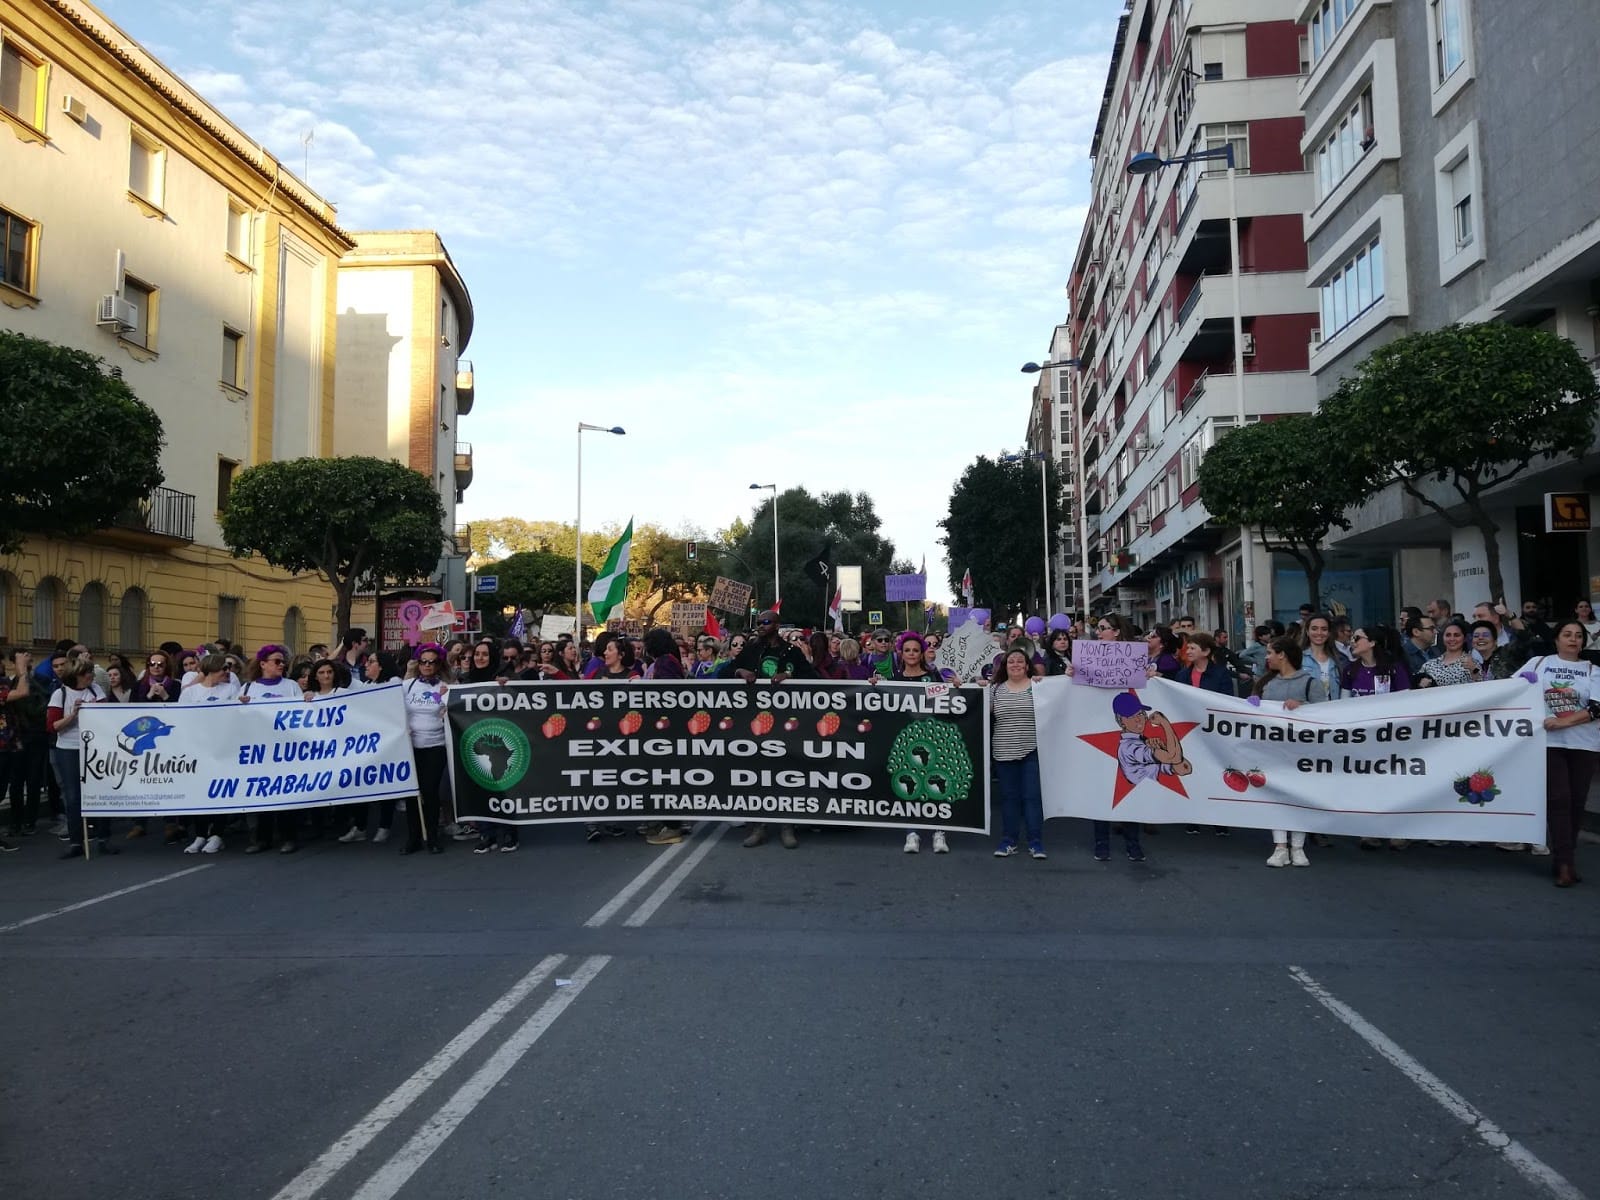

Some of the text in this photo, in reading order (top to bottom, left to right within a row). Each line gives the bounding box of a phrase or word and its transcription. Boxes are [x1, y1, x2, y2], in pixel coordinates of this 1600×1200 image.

[384, 630, 402, 640] TIENE
[1080, 642, 1132, 657] MONTERO
[1080, 657, 1093, 666] ES
[1094, 668, 1132, 679] QUIERO
[460, 690, 967, 715] TODAS LAS PERSONAS SOMOS IGUALES
[274, 704, 347, 731] KELLYS
[1202, 714, 1534, 744] Jornaleras de Huelva
[238, 732, 381, 765] EN LUCHA POR
[568, 738, 866, 760] EXIGIMOS UN
[80, 748, 198, 790] Kellys Unión
[1296, 754, 1427, 776] en lucha
[208, 760, 411, 799] UN TRABAJO DIGNO
[561, 768, 872, 790] TECHO DIGNO
[488, 794, 952, 819] COLECTIVO DE TRABAJADORES AFRICANOS
